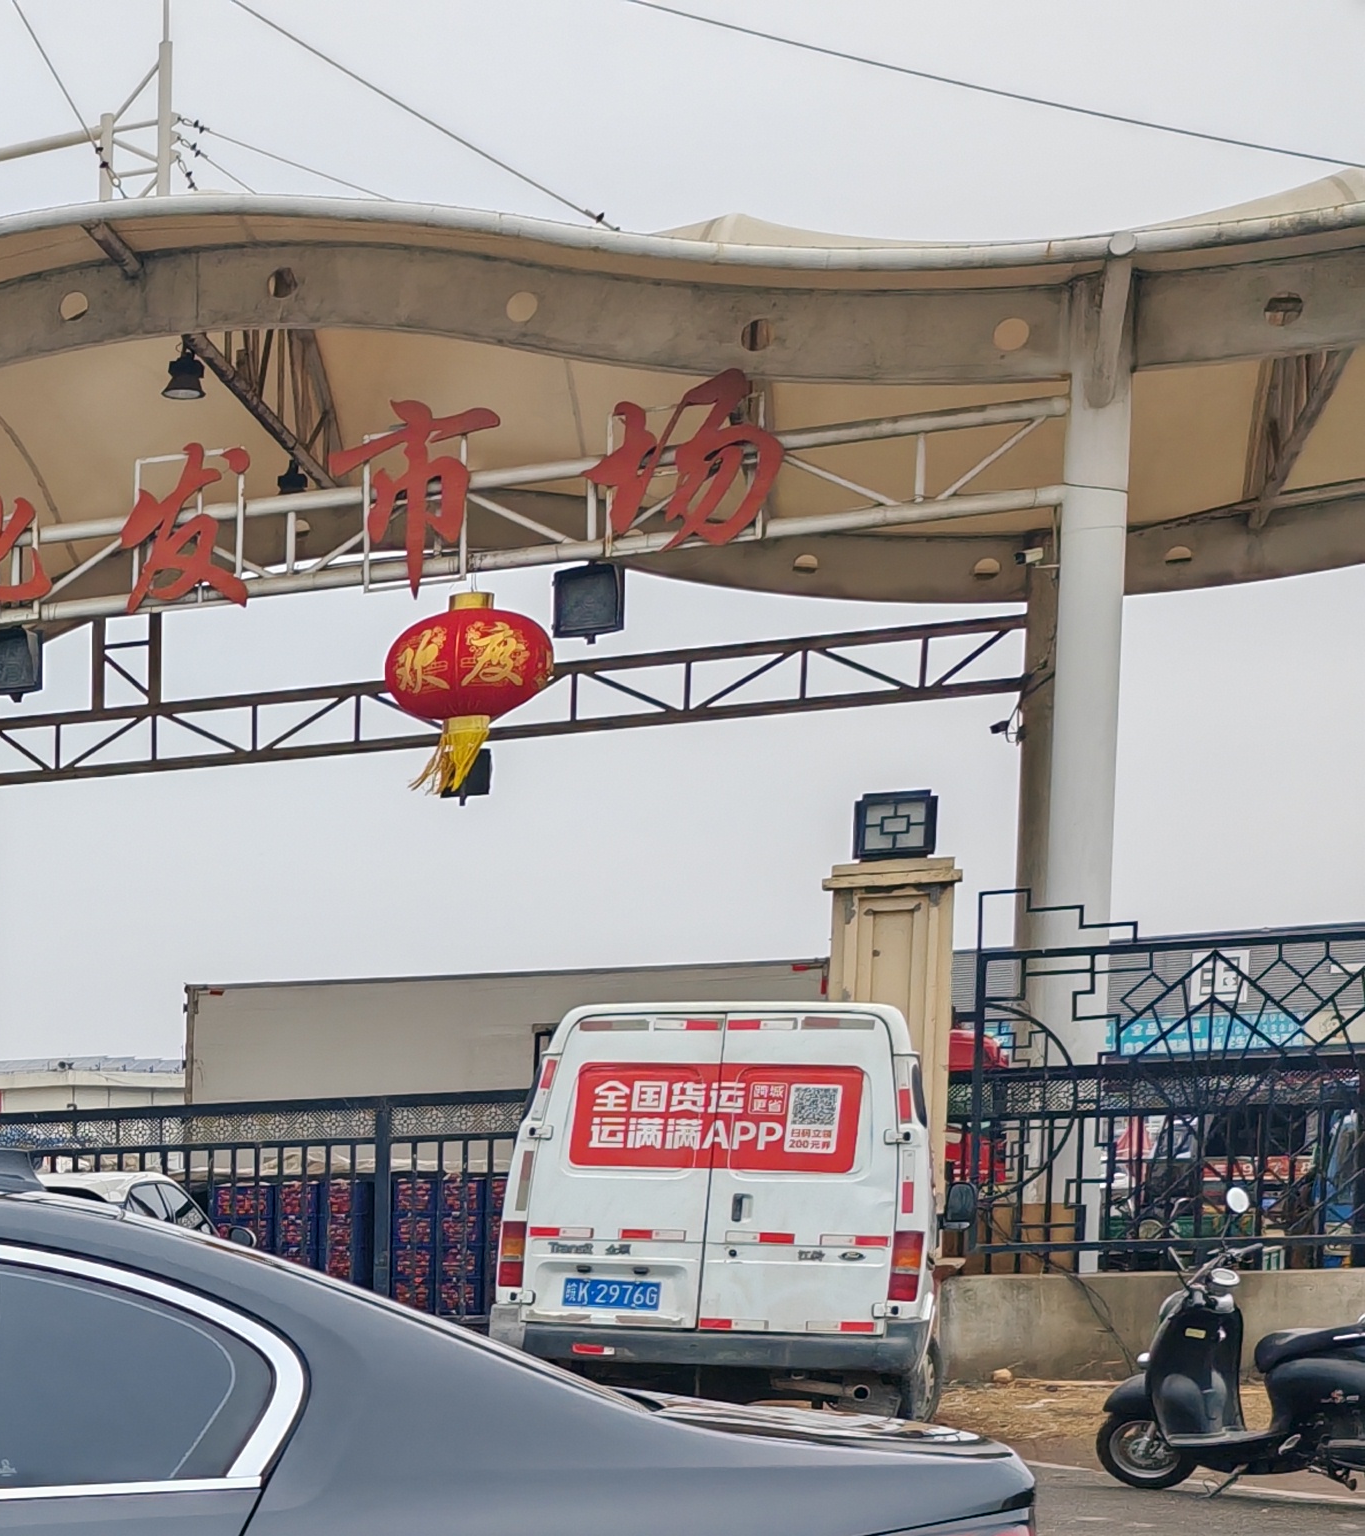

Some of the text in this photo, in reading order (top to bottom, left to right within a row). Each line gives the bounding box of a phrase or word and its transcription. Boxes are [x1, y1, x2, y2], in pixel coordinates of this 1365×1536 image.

[592, 1080, 746, 1114] 全国货运
[588, 1117, 783, 1151] 运满满APP
